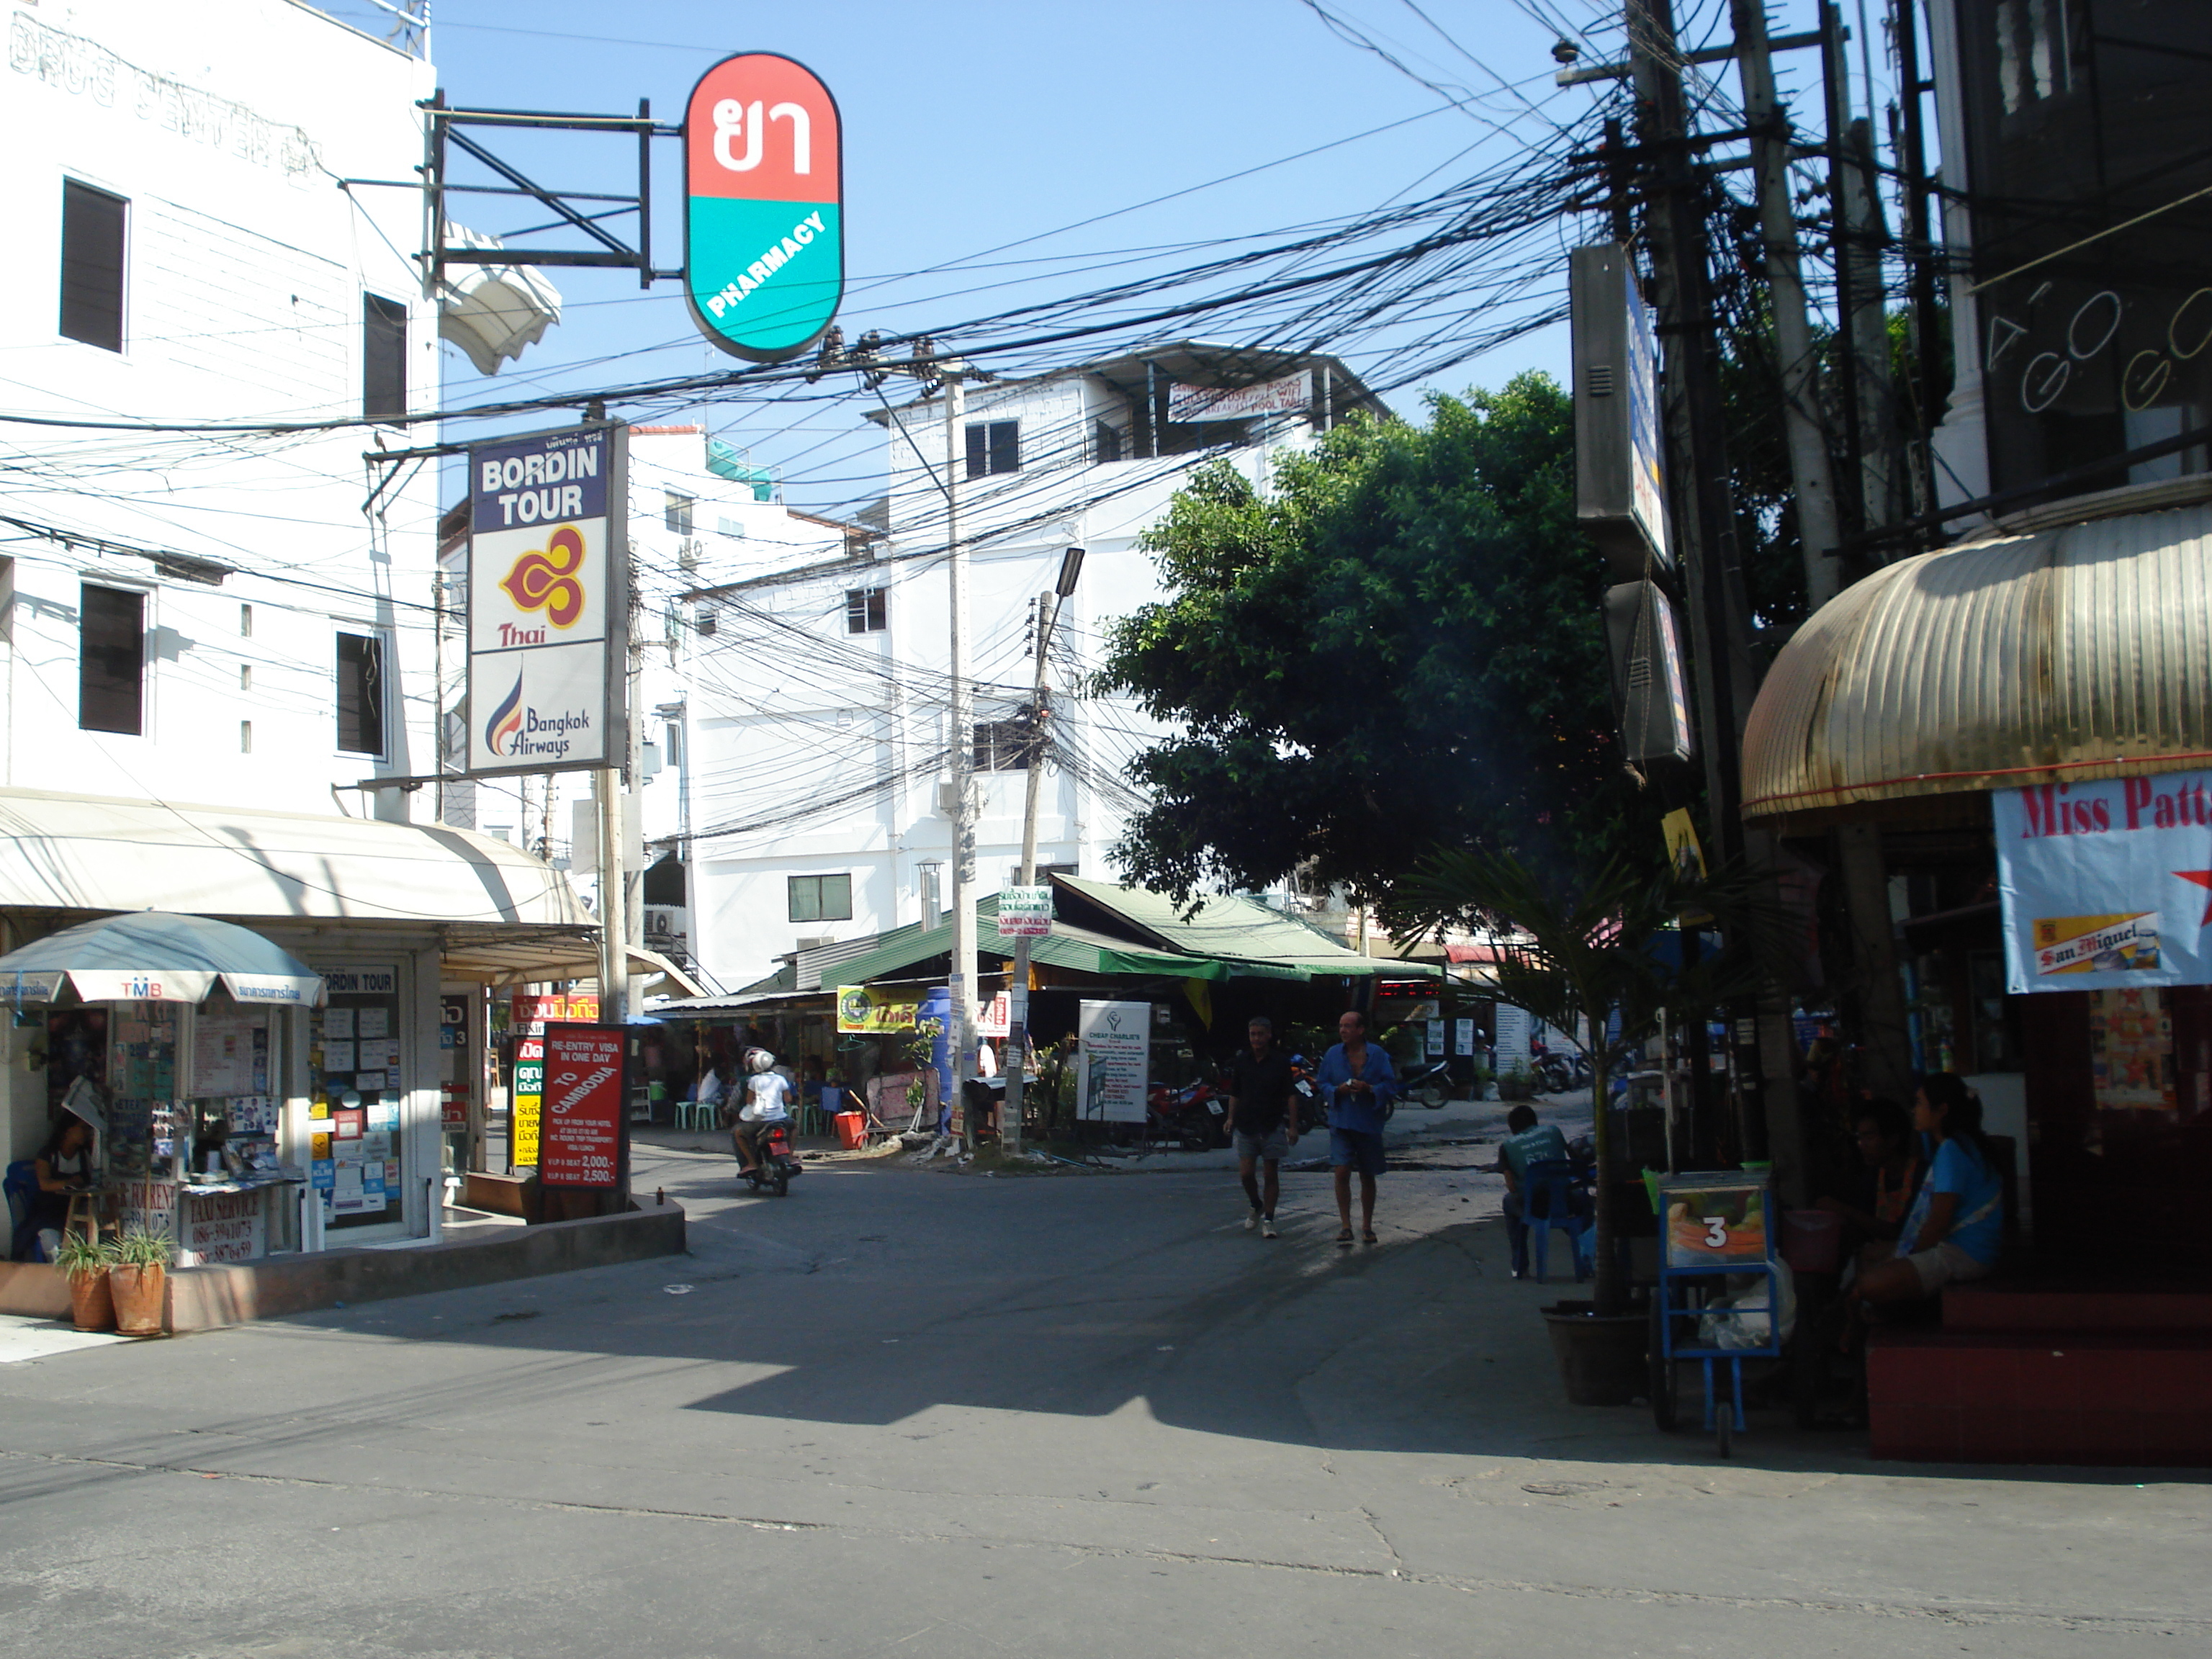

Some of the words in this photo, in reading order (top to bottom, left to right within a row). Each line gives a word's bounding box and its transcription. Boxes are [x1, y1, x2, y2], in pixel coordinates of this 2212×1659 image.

[711, 98, 811, 175] ยา
[706, 210, 827, 319] PHARMACY
[482, 445, 598, 493] BORDIN
[498, 485, 583, 526] TOUR
[497, 621, 546, 647] Thai
[526, 706, 590, 737] Bangkok
[508, 728, 570, 759] Airways
[2021, 782, 2112, 839] Miss
[2041, 948, 2076, 967] San
[2077, 922, 2139, 957] Miguel
[121, 978, 163, 997] TMB
[319, 973, 358, 991] ORDIN
[362, 973, 392, 991] TOUR
[457, 1031, 467, 1045] 3
[552, 1040, 595, 1052] RE-ENTRY
[598, 1043, 619, 1053] VISA
[561, 1052, 570, 1061] IN
[571, 1052, 590, 1062] ONE
[593, 1053, 611, 1063] DAY
[551, 1066, 618, 1115] CAMBODIA
[553, 1071, 579, 1087] TO
[582, 1155, 615, 1169] 2,000.-
[583, 1169, 616, 1183] 2,500.-
[150, 1183, 176, 1210] RENT
[191, 1198, 214, 1223] TAXI
[217, 1192, 258, 1220] SERVICE
[1704, 1216, 1726, 1249] 3
